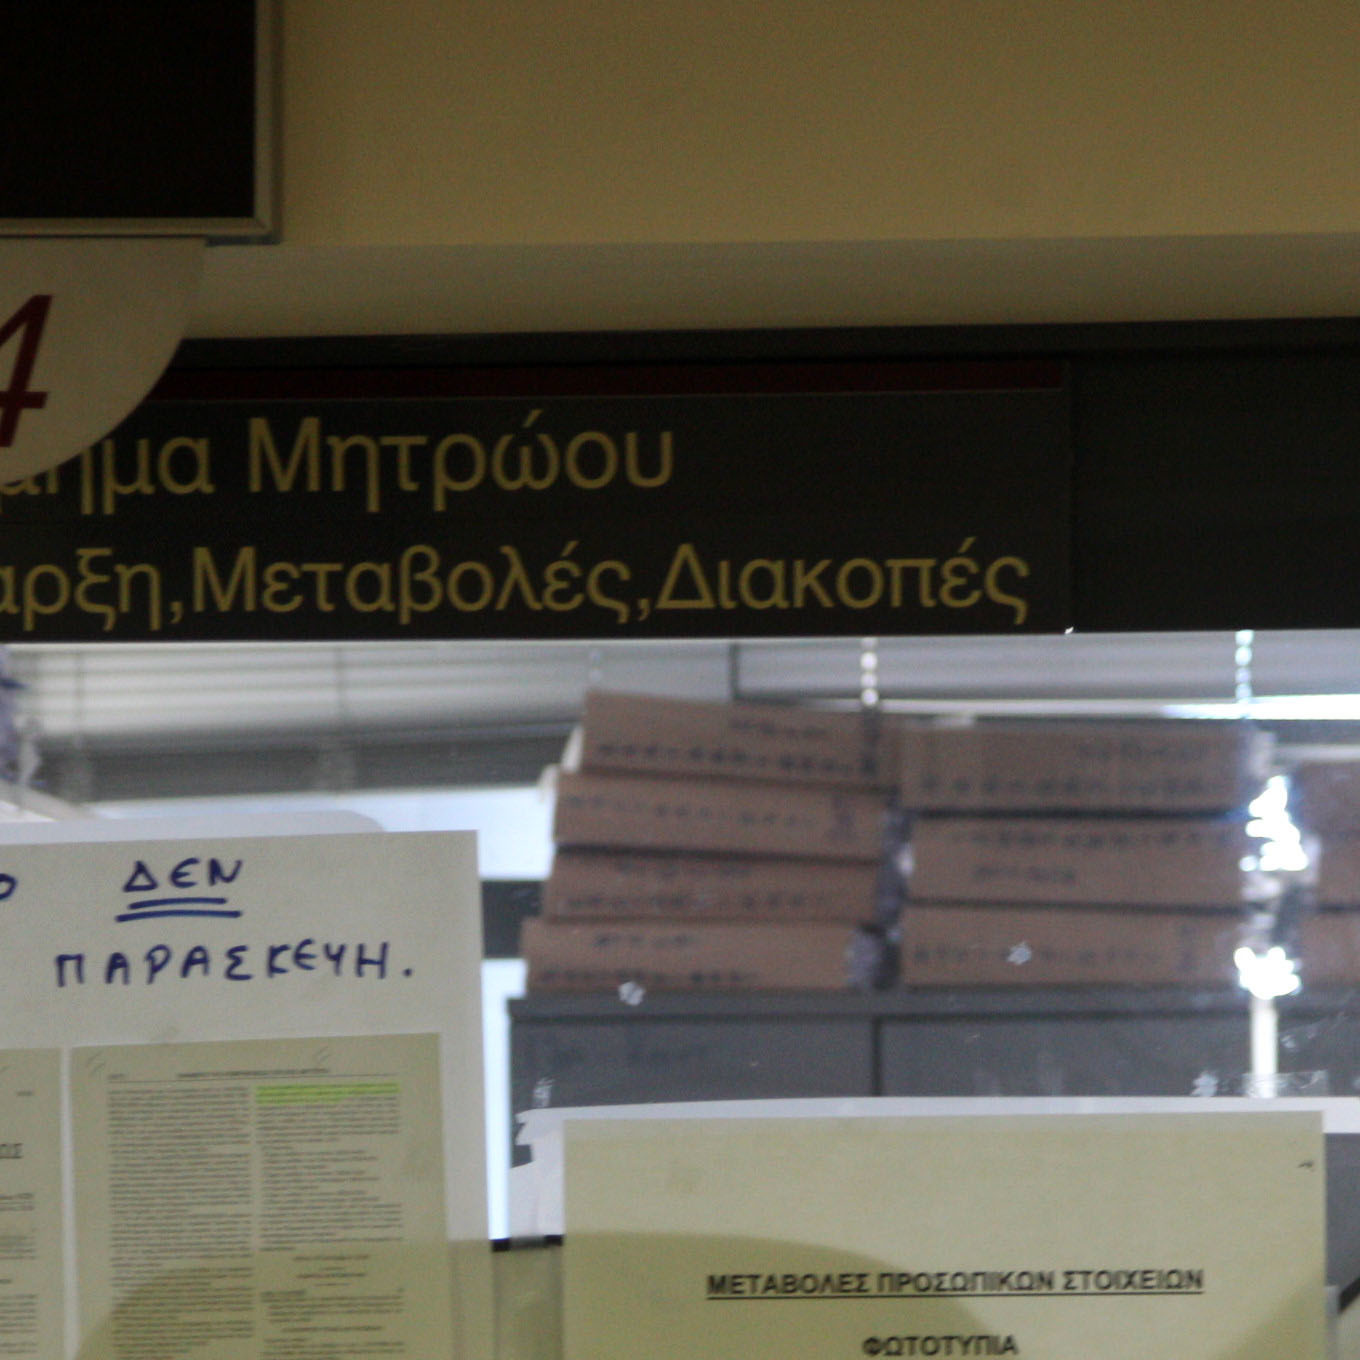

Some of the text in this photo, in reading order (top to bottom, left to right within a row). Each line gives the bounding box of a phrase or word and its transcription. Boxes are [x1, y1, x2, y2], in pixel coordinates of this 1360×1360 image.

[250, 409, 673, 512] Μητρώου
[120, 855, 247, 893] ΔΕΝ
[706, 1266, 1206, 1294] ΜΕΤΑΒΟΛΕΣ ΠΡΟΣΩΠΙΚΩΝ ΣΤΟΙΧΕΙΩΝ
[862, 1335, 1019, 1358] ΦΩΤΟΤΥΠΙΑ
